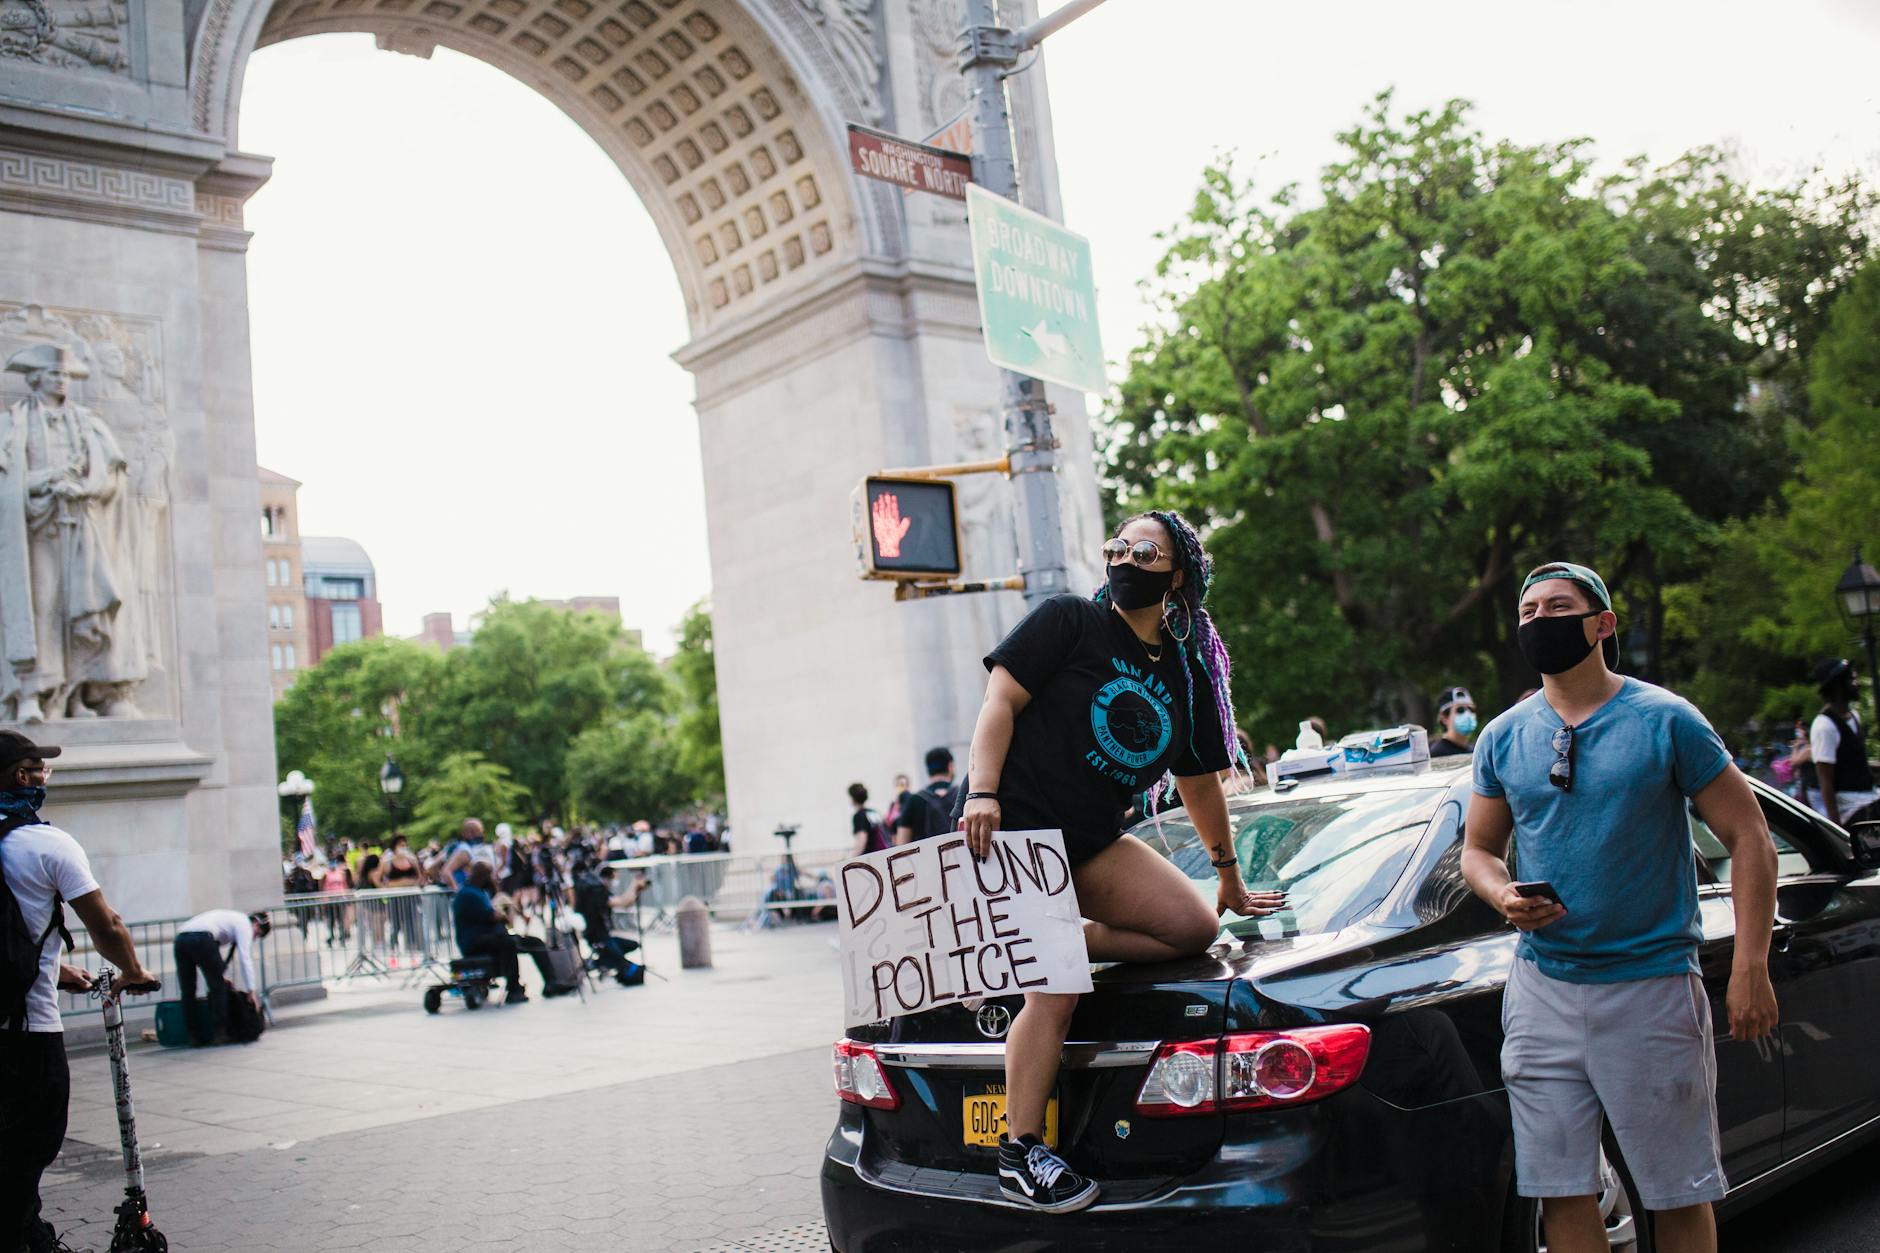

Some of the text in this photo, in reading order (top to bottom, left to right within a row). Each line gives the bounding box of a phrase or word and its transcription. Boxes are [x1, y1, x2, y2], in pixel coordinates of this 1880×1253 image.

[858, 147, 918, 185] SQUARE
[881, 141, 943, 168] WASHINGTON
[987, 217, 1079, 279] BROADWAY
[990, 260, 1088, 321] DOWNTOWN
[1097, 725, 1124, 760] PANTHER
[1126, 752, 1147, 762] POWER
[913, 896, 1020, 948] THE
[872, 938, 1048, 1019] POLICE
[971, 1101, 998, 1134] GDG
